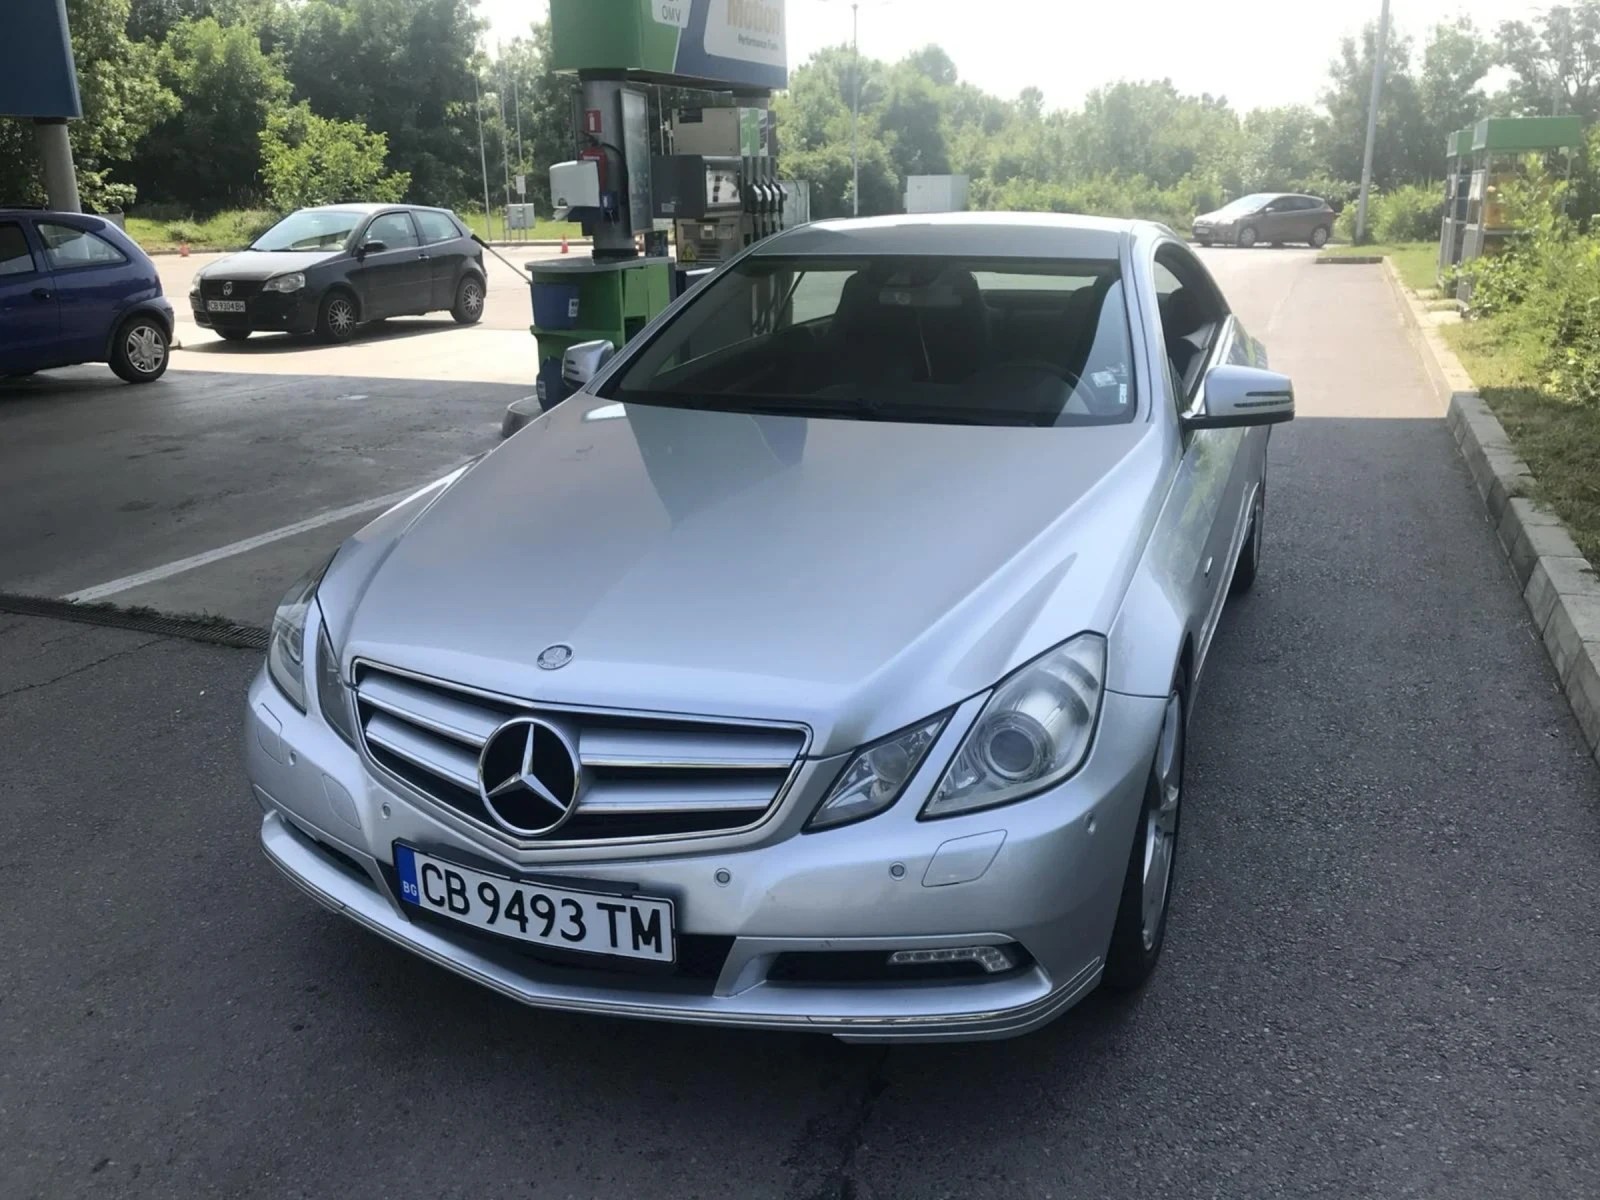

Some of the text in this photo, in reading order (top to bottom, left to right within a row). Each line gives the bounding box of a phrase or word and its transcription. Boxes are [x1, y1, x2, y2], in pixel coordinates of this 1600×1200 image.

[661, 5, 681, 22] OMV
[219, 302, 234, 310] 9304
[402, 880, 418, 897] BG
[421, 862, 663, 954] CB 9493 TM
